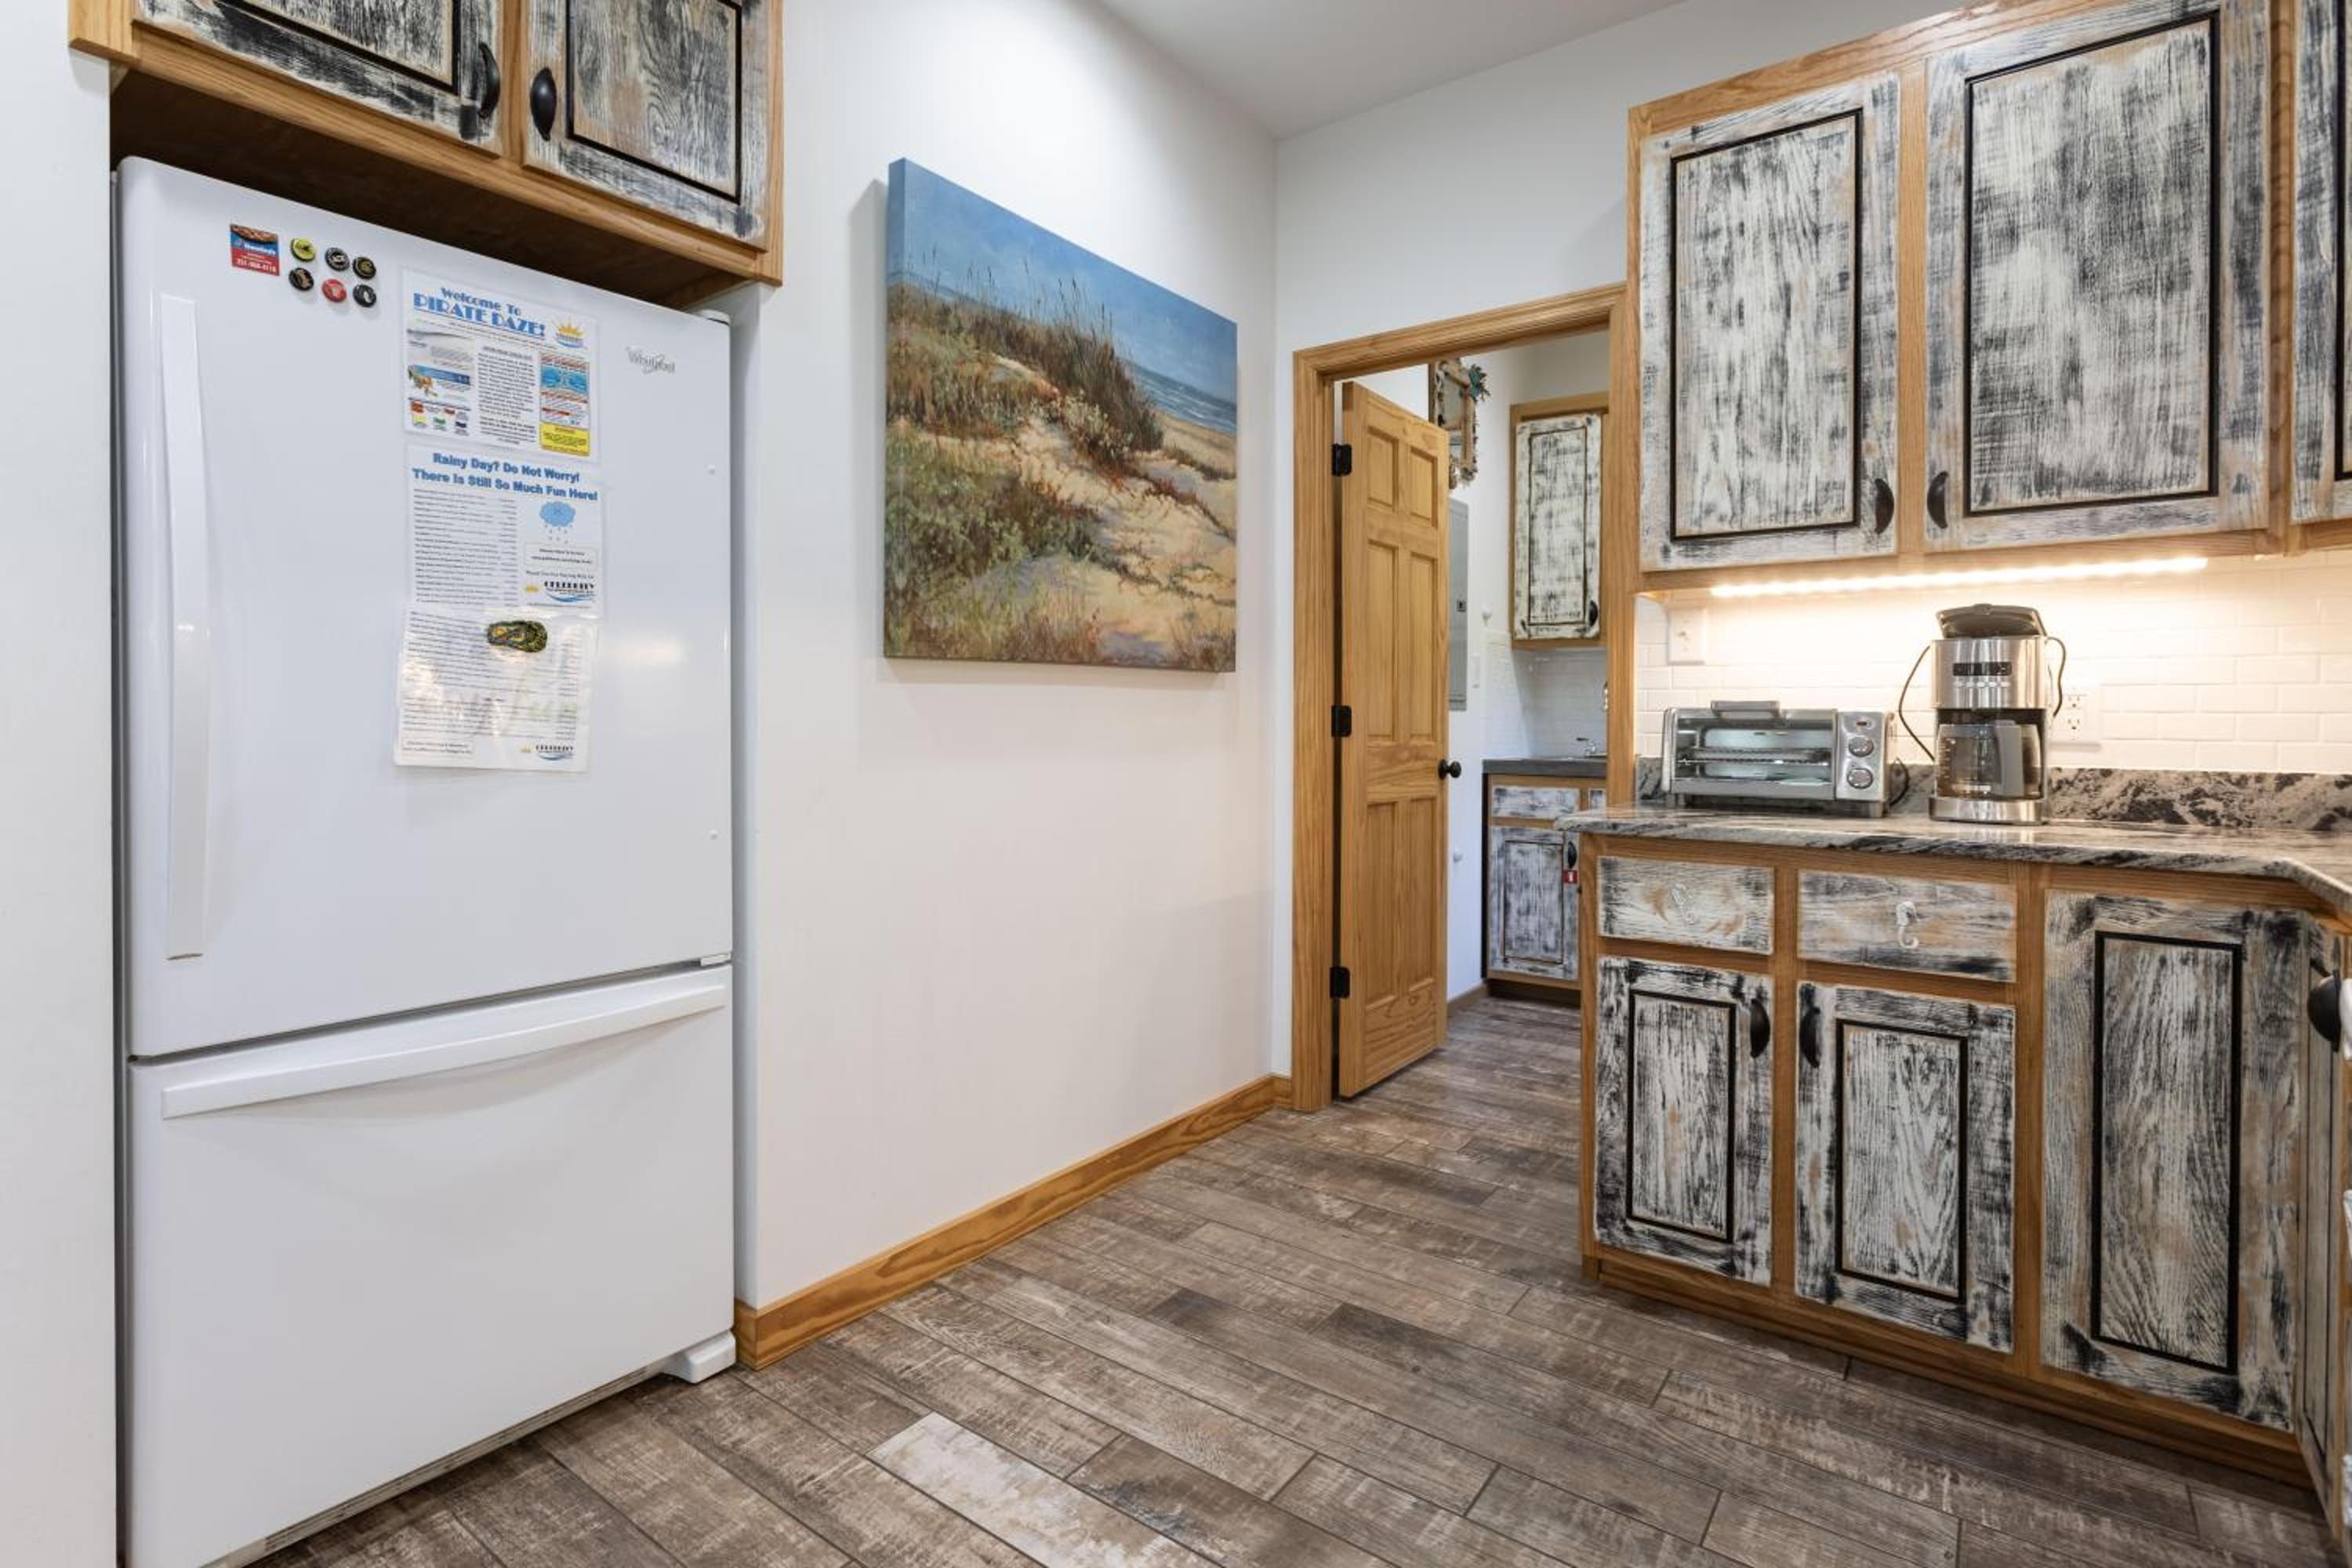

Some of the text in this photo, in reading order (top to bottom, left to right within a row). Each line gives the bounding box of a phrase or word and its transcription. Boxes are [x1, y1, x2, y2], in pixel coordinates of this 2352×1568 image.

[413, 292, 487, 322] PIRATE
[491, 310, 546, 337] DAZE!
[440, 287, 522, 315] Welcome To
[412, 467, 598, 501] There Is Still So Much Fun Here!
[433, 452, 580, 484] Rainy Day? Do Not Worry!
